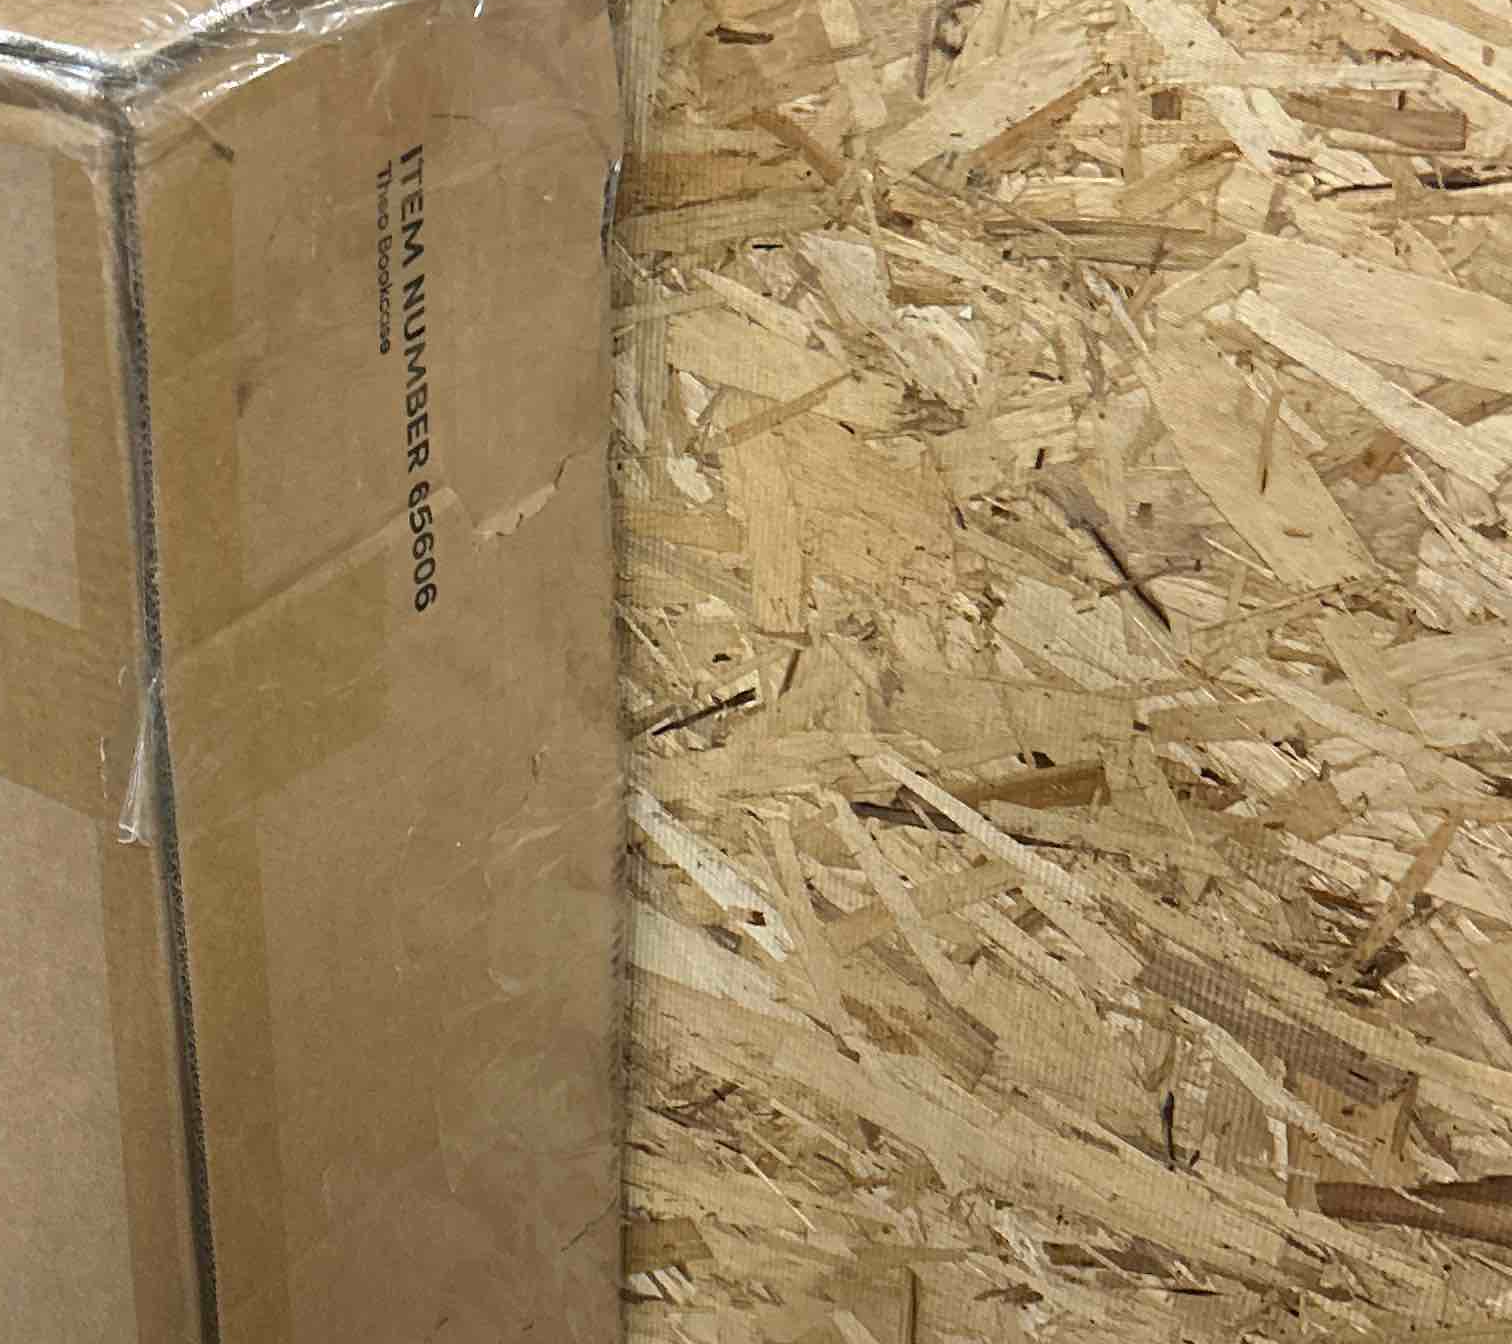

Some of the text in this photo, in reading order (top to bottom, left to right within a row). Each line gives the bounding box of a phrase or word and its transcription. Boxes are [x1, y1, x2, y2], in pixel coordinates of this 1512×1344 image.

[377, 159, 393, 356] Theo Bookcase
[400, 143, 437, 614] ITEM NUMBER 65606
